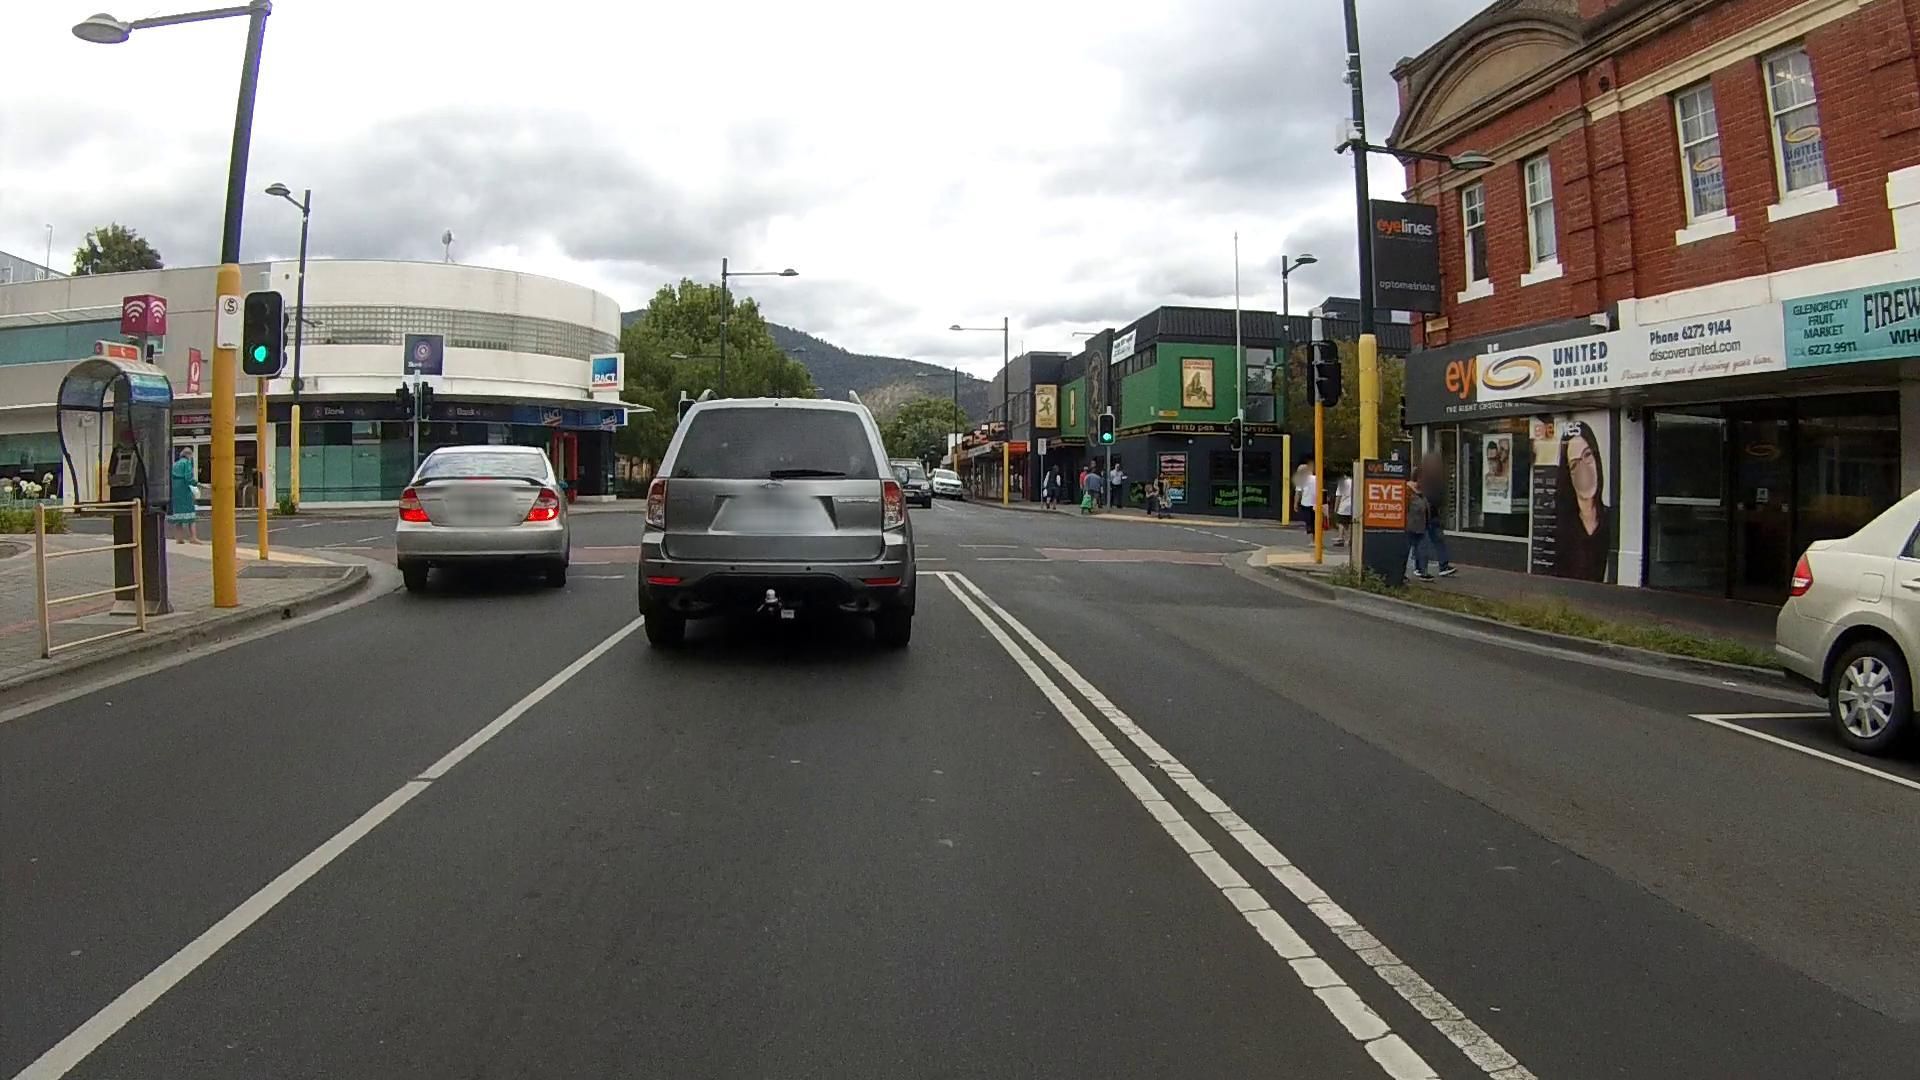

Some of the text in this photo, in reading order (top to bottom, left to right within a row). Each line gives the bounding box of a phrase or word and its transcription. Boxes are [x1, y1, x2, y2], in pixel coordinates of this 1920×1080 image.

[1376, 218, 1433, 235] eyelines
[1380, 280, 1436, 292] optometrists
[1793, 298, 1848, 316] GLENORCHY
[1808, 313, 1834, 326] FRUIT
[1650, 319, 1732, 345] Phone 6272 9144
[1803, 324, 1845, 339] MARKET
[1889, 328, 1920, 345] WH
[1552, 341, 1608, 365] UNITED
[1649, 340, 1741, 362] discoverunited.com
[1808, 343, 1832, 356] 6272
[1834, 341, 1857, 353] 9911
[594, 373, 617, 383] RACT
[1553, 361, 1608, 378] HOME LOANS
[1553, 376, 1608, 389] TASMANIA
[1368, 484, 1403, 501] EYE
[1369, 502, 1403, 511] TESTING
